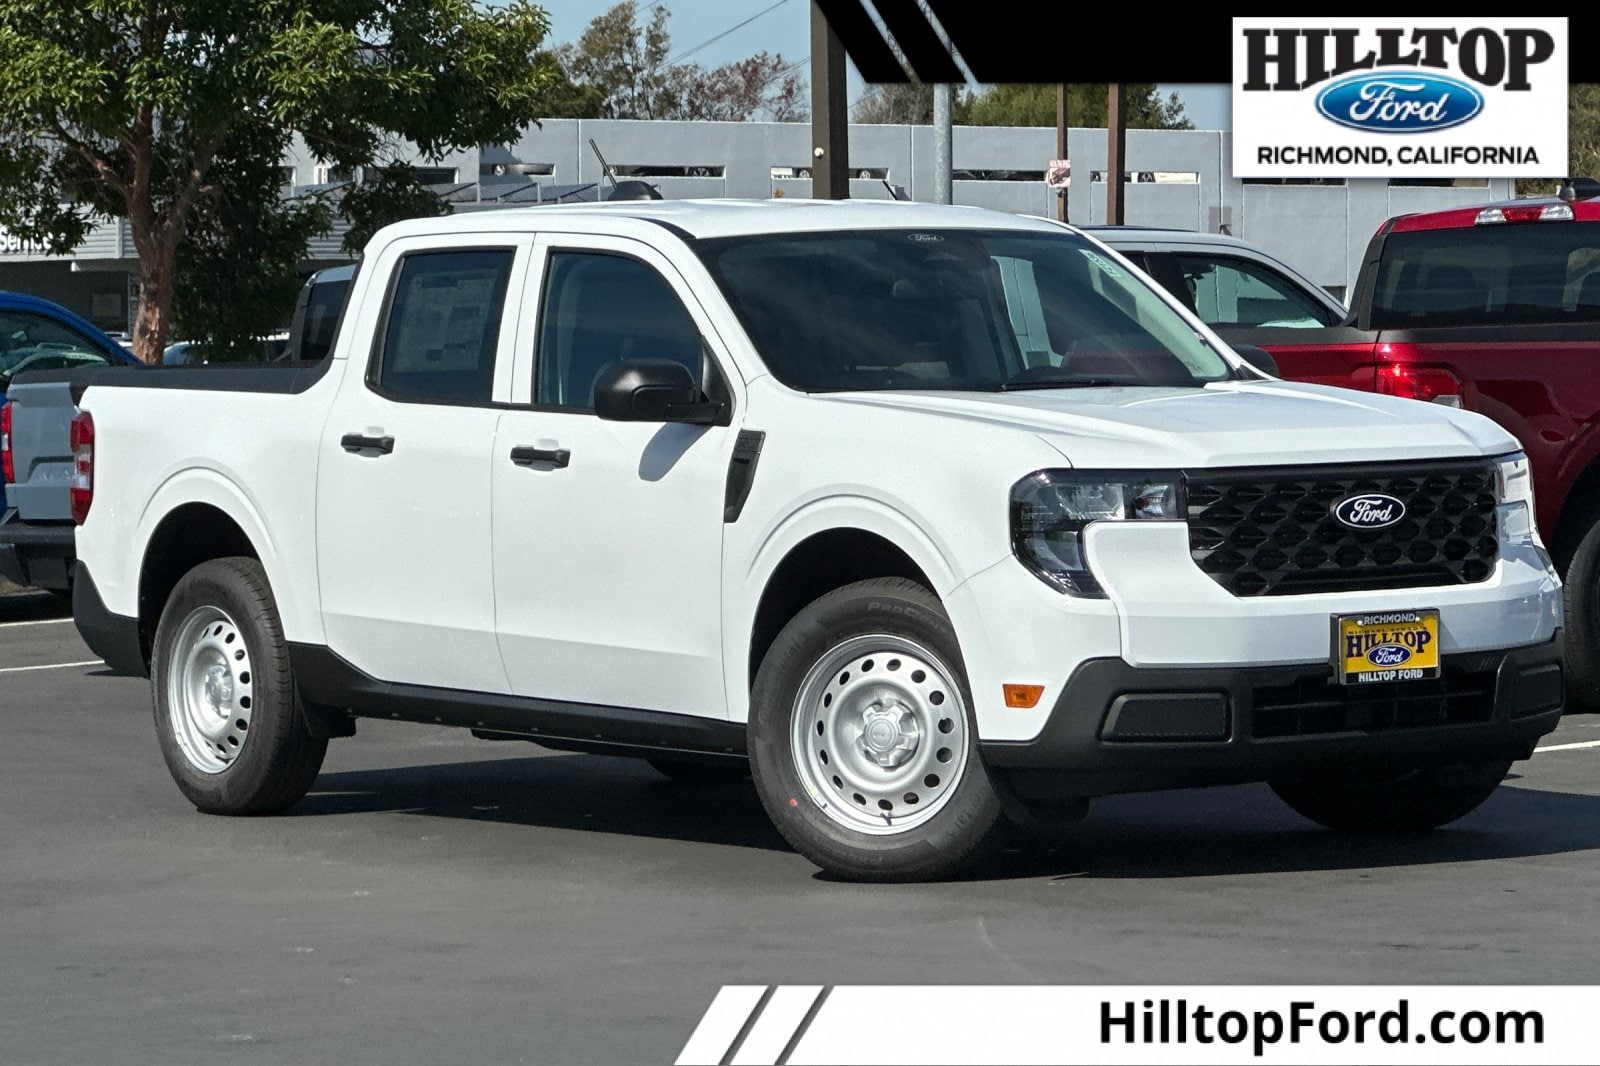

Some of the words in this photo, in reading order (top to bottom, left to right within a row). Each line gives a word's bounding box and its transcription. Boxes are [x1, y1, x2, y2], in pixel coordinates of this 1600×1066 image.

[1349, 499, 1393, 523] Ford
[1364, 613, 1415, 624] RICHMOND
[1346, 630, 1431, 658] HILLTOP
[1375, 647, 1404, 663] Ford
[1358, 670, 1396, 682] HILLTOP
[1398, 669, 1424, 680] FORD
